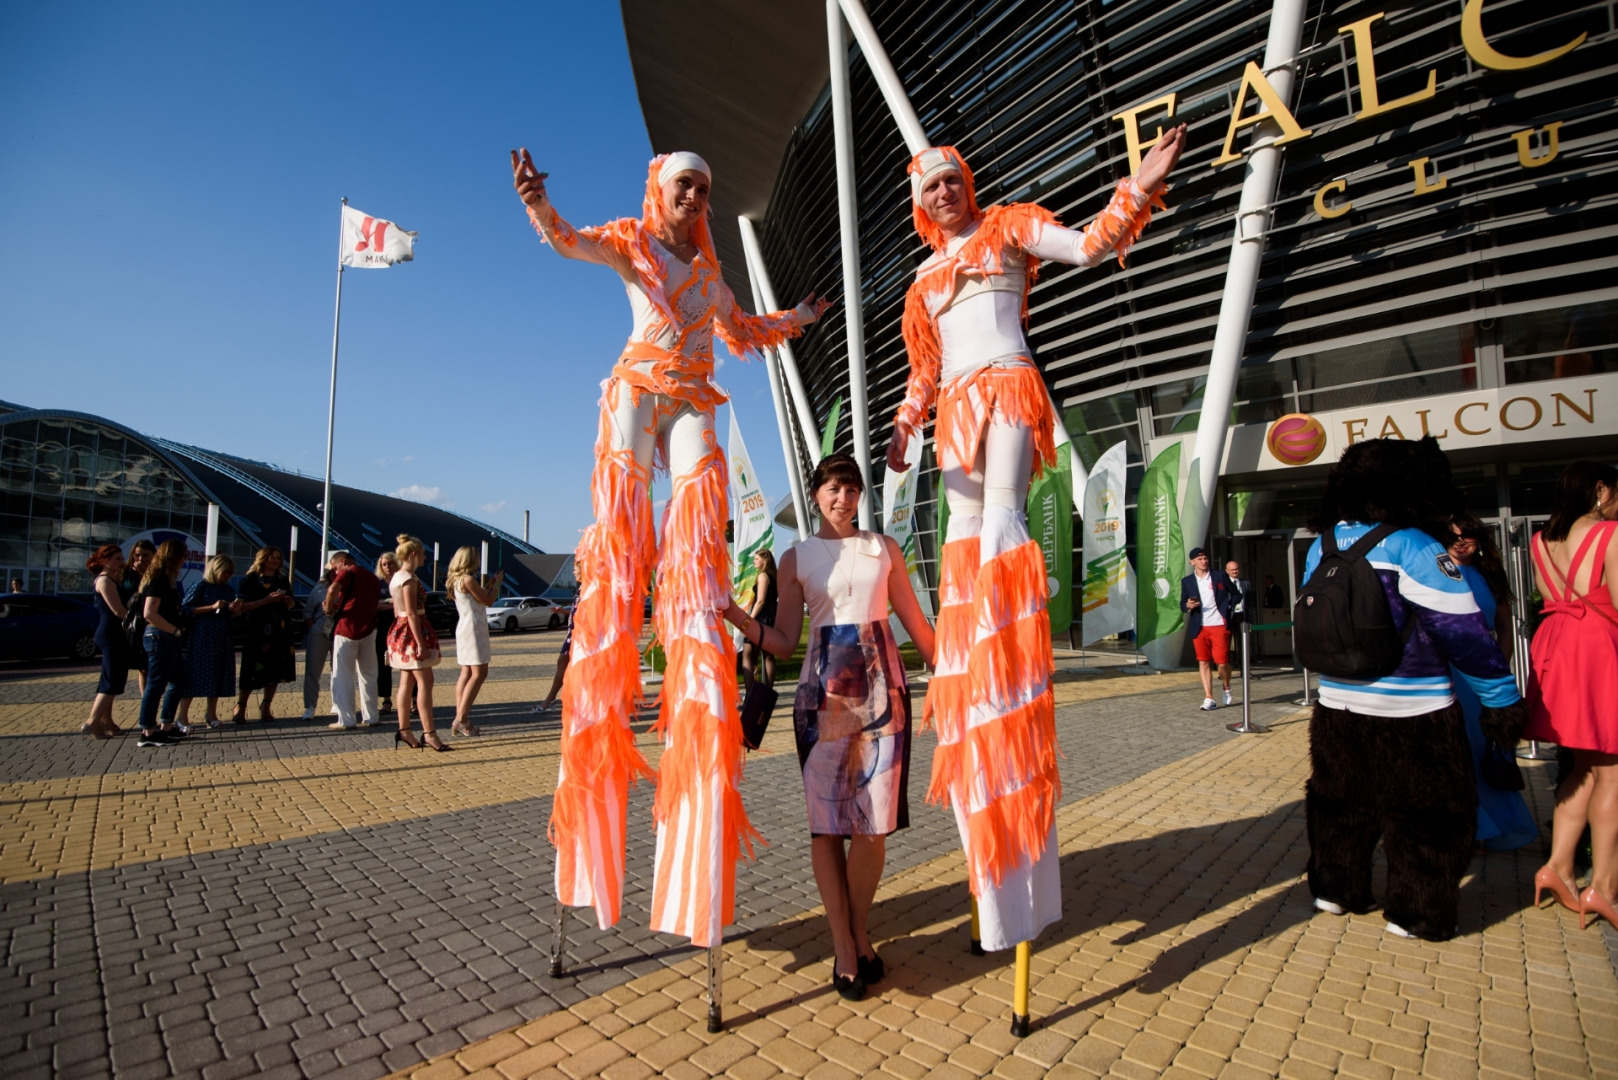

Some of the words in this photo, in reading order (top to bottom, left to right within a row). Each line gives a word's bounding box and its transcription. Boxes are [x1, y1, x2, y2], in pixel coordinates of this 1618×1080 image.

[1341, 388, 1598, 446] FALCON
[742, 493, 764, 514] 2019
[1093, 520, 1120, 534] 2019
[1042, 493, 1054, 573] СБЕРБАНК
[1153, 494, 1166, 574] SBERBANK
